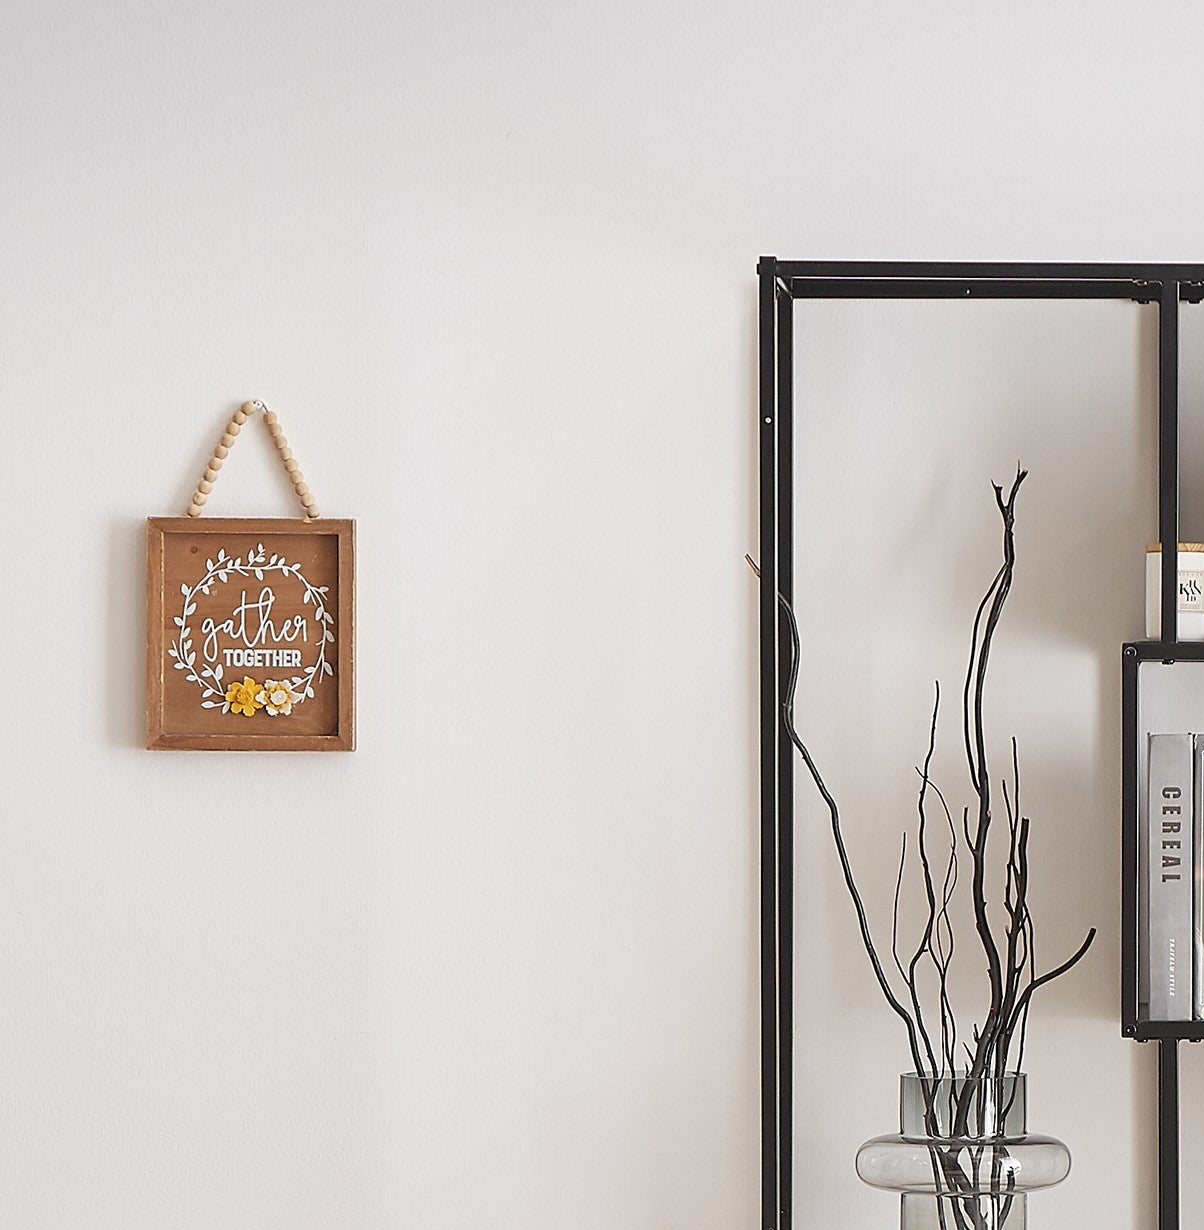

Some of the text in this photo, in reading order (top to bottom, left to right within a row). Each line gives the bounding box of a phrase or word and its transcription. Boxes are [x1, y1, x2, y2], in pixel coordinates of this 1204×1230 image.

[201, 587, 308, 662] gather
[223, 648, 302, 667] TOGETHER
[1162, 786, 1181, 883] CEREAL
